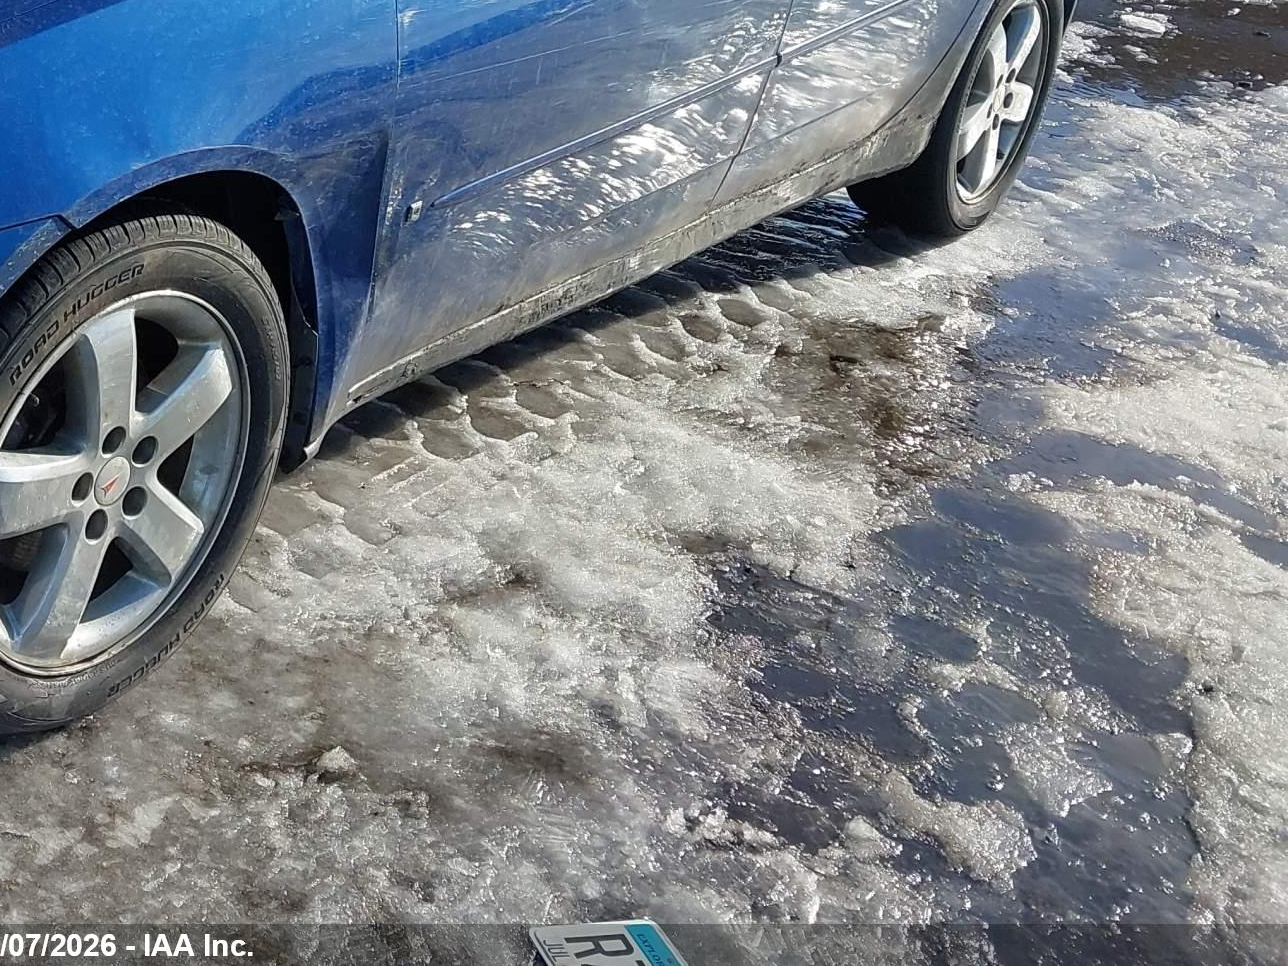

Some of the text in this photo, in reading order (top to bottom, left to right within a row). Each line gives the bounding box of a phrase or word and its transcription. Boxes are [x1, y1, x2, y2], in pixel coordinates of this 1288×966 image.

[8, 263, 145, 385] ROAD HUGGER
[184, 573, 225, 634] ROAD
[543, 939, 570, 963] JUL
